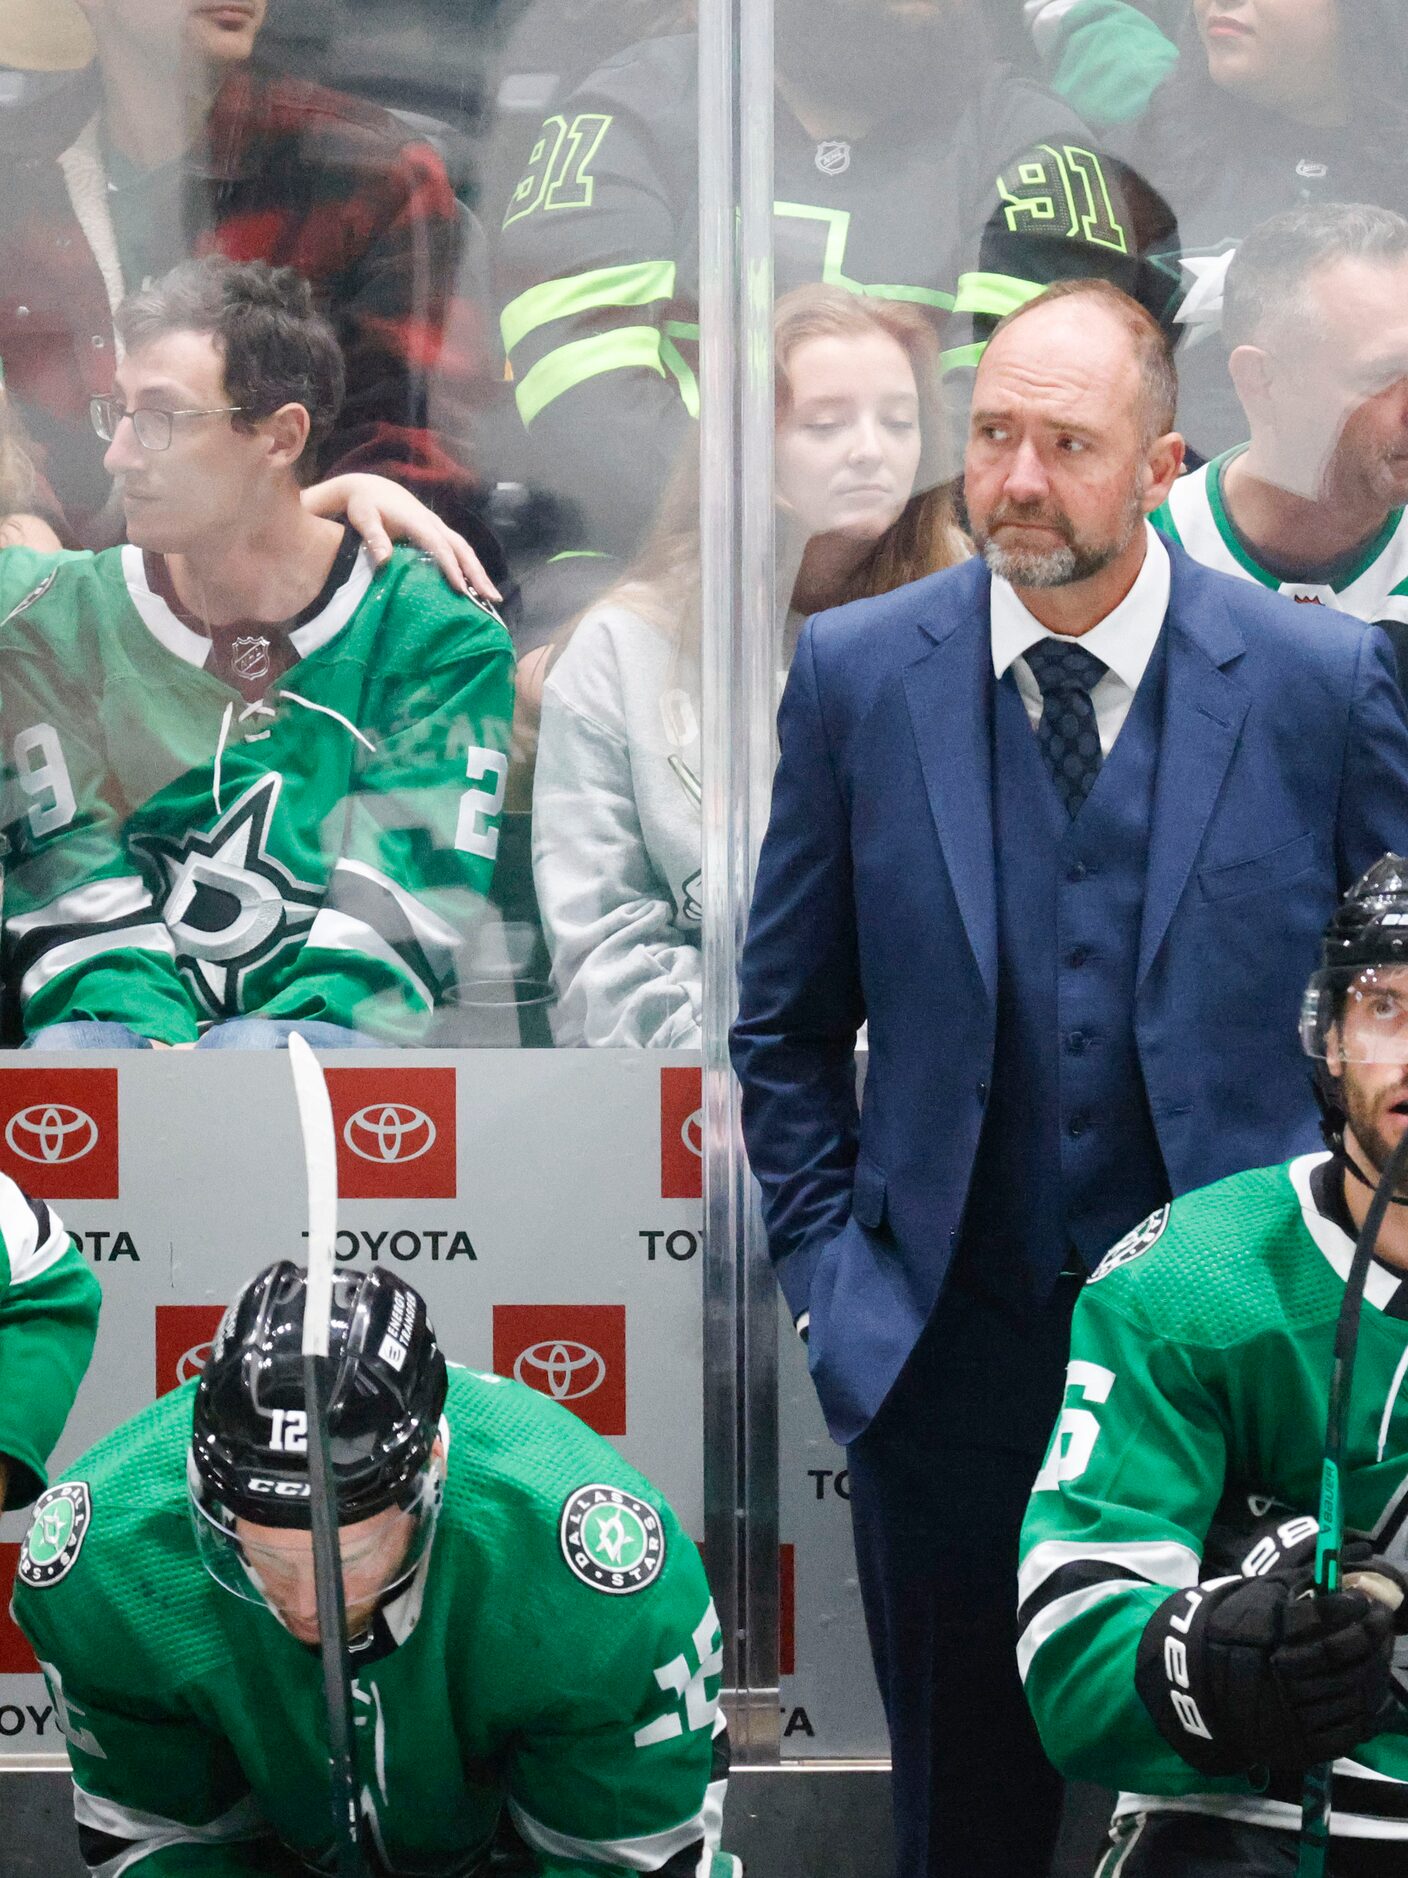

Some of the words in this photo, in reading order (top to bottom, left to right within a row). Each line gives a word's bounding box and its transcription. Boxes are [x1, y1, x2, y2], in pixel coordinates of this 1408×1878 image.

[502, 113, 613, 231] 91
[996, 144, 1128, 254] 91
[14, 722, 77, 837] 9
[454, 746, 508, 860] 2
[302, 1230, 477, 1261] OYOTA
[387, 1289, 406, 1337] ENERGY
[269, 1408, 308, 1452] 12
[248, 1478, 311, 1497] CC
[568, 1491, 624, 1569] DALLAS
[611, 1516, 660, 1587] STARS
